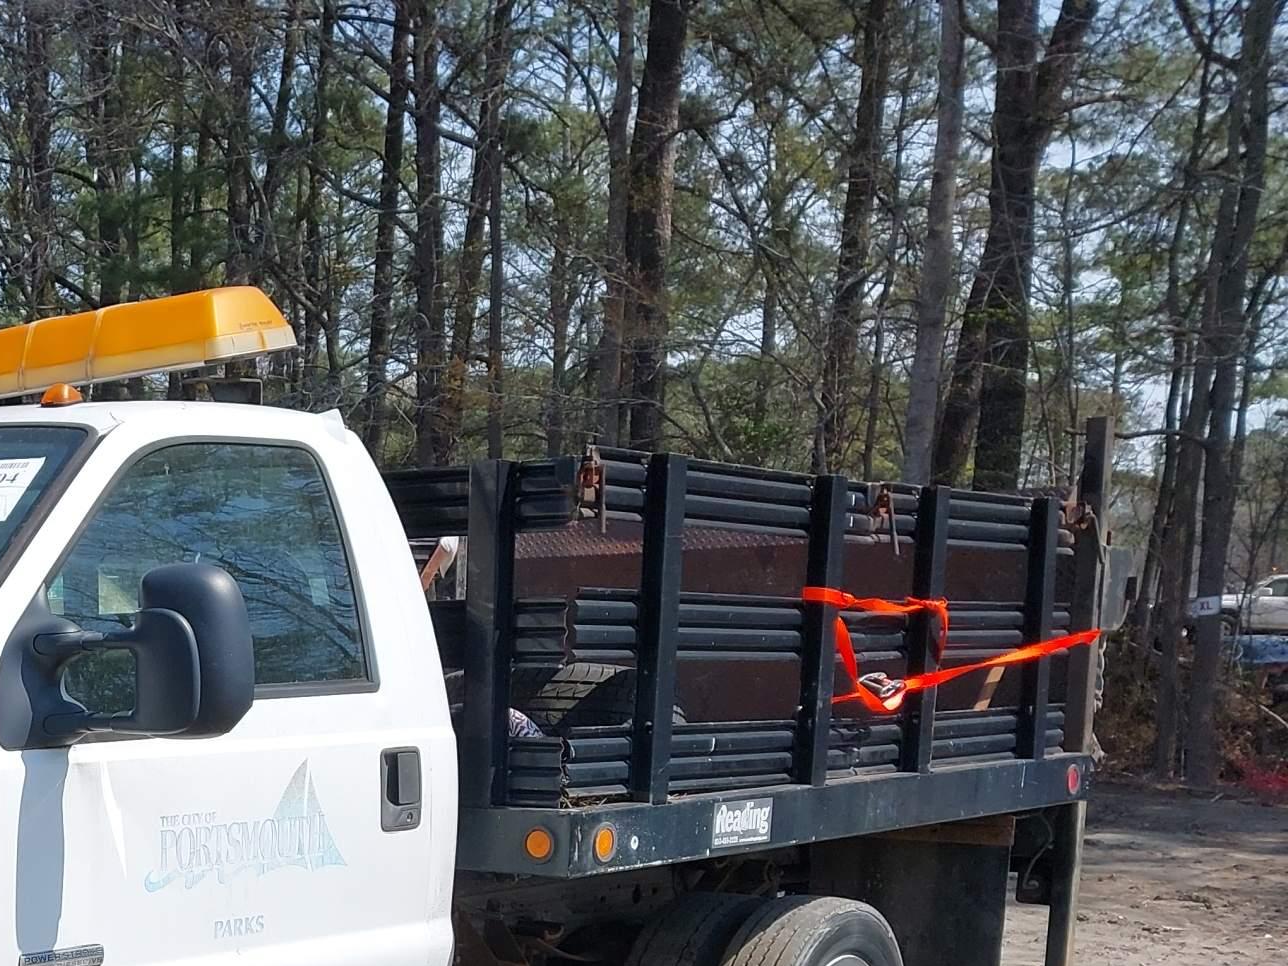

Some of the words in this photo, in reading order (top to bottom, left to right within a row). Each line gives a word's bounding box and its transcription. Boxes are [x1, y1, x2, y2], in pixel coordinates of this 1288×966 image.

[160, 814, 180, 827] THE
[181, 812, 203, 826] CITY
[204, 810, 216, 824] OF
[715, 801, 770, 835] Reading
[160, 812, 324, 871] PORTSMOUTH
[213, 914, 265, 939] PARKS
